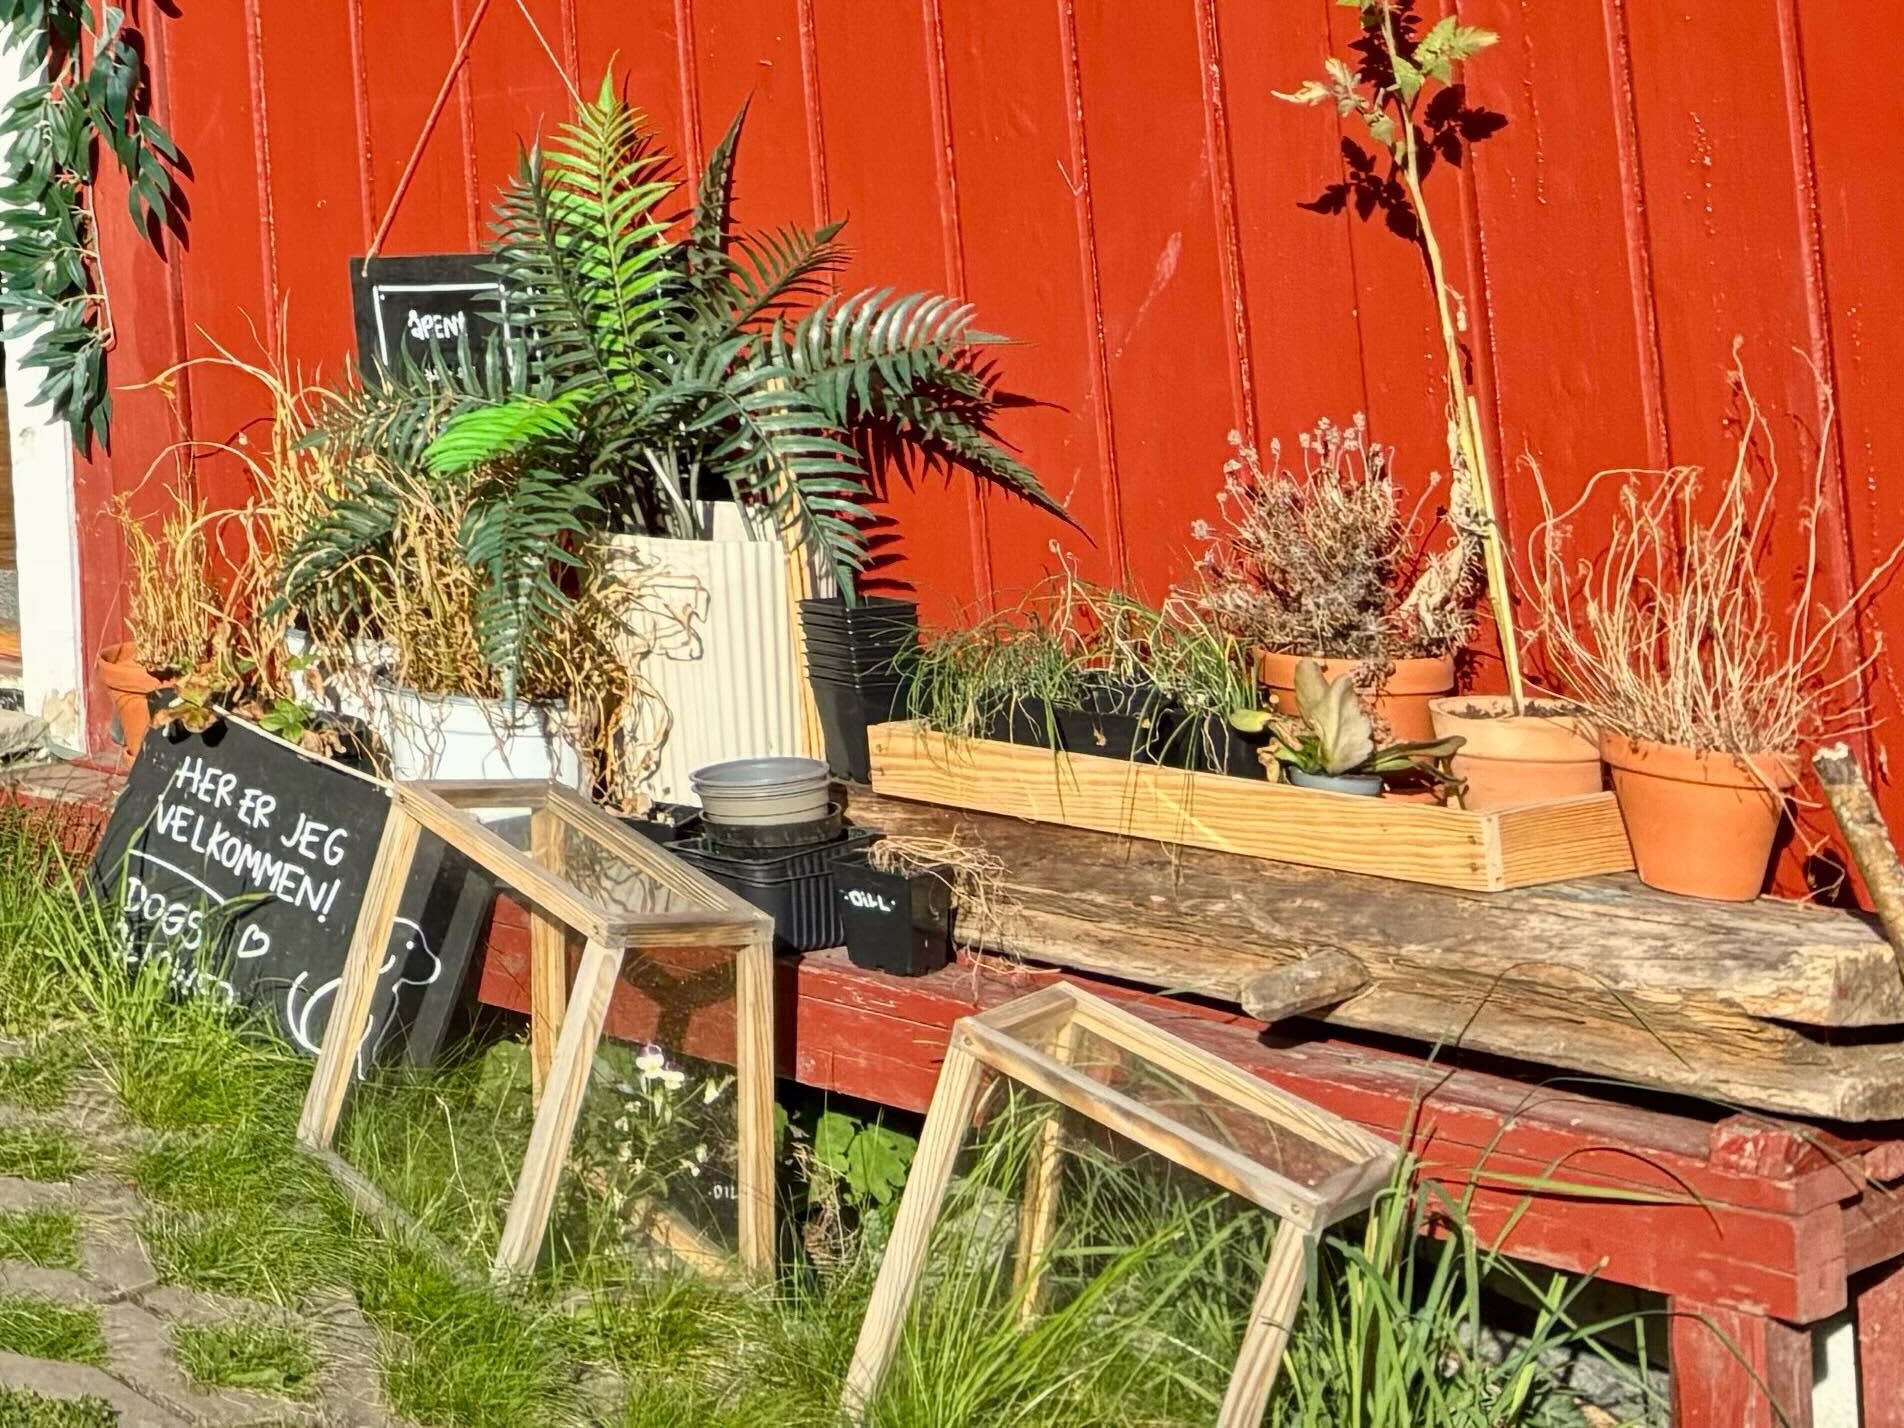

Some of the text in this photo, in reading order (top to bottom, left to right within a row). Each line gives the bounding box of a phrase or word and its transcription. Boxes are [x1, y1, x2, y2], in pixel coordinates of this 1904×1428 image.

[154, 798, 342, 925] VELKOMMEN!
[172, 755, 349, 866] HER ER JEG
[123, 875, 206, 951] DOGS
